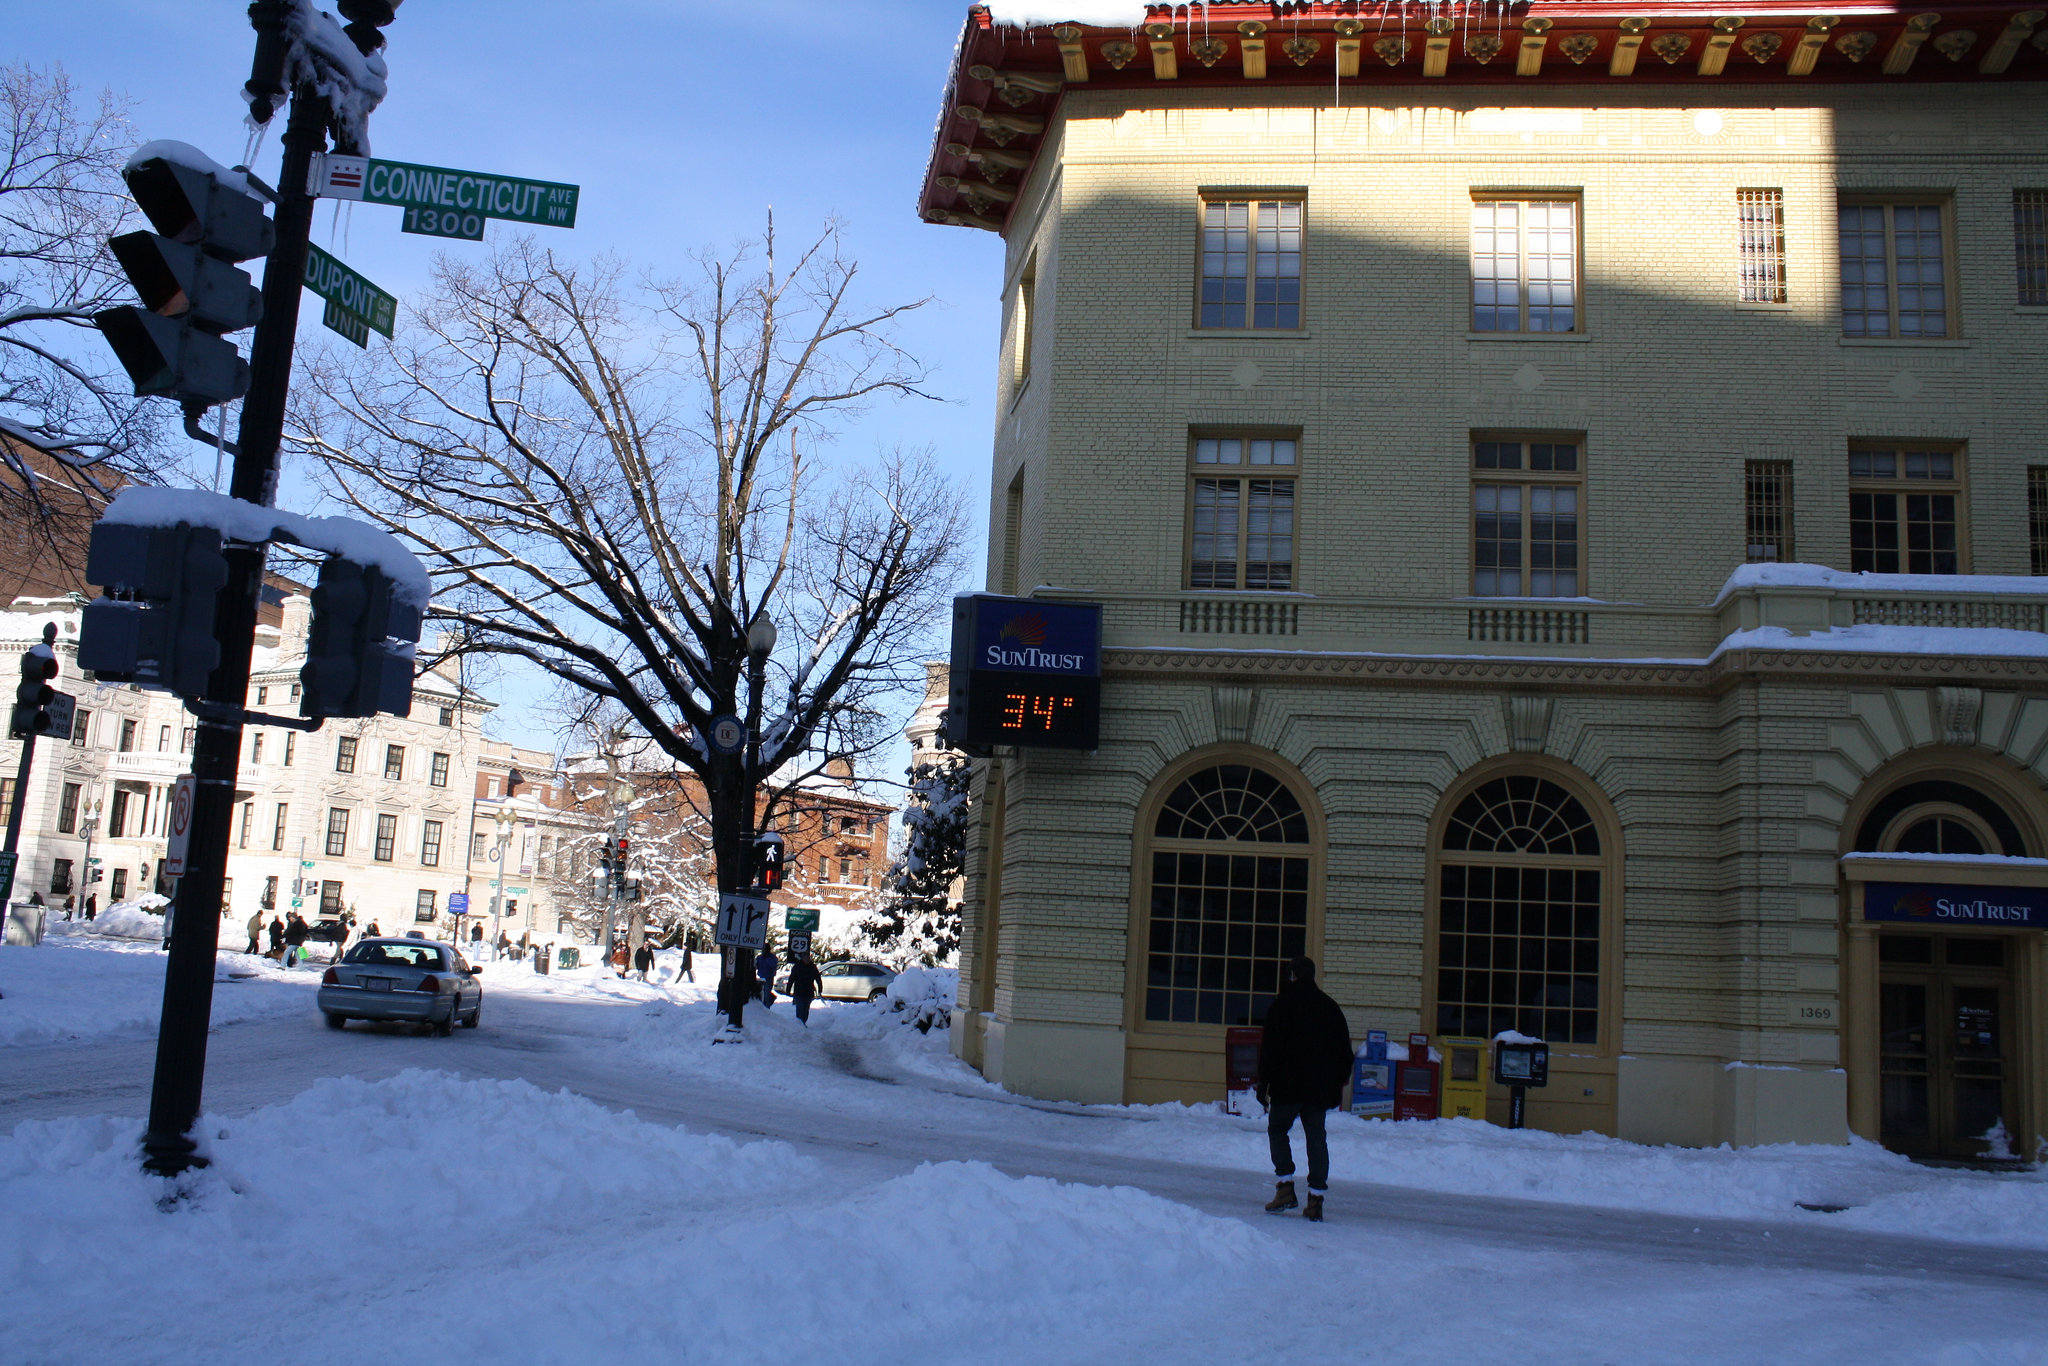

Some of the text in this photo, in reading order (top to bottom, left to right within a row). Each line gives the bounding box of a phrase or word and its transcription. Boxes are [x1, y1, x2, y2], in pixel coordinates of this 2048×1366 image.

[370, 165, 545, 217] CONNECTICUT
[548, 189, 572, 205] AVE
[548, 206, 567, 221] NW
[407, 209, 481, 237] 1300
[305, 250, 377, 320] DUPONT
[378, 295, 391, 312] CIR
[326, 307, 369, 344] UNIT
[376, 312, 389, 329] NW
[54, 698, 66, 708] NO
[50, 709, 68, 721] TURN
[55, 723, 70, 734] RED
[720, 932, 738, 942] ONLY
[743, 936, 760, 945] ONLY
[793, 939, 806, 950] 29
[1801, 1007, 1831, 1019] 1369
